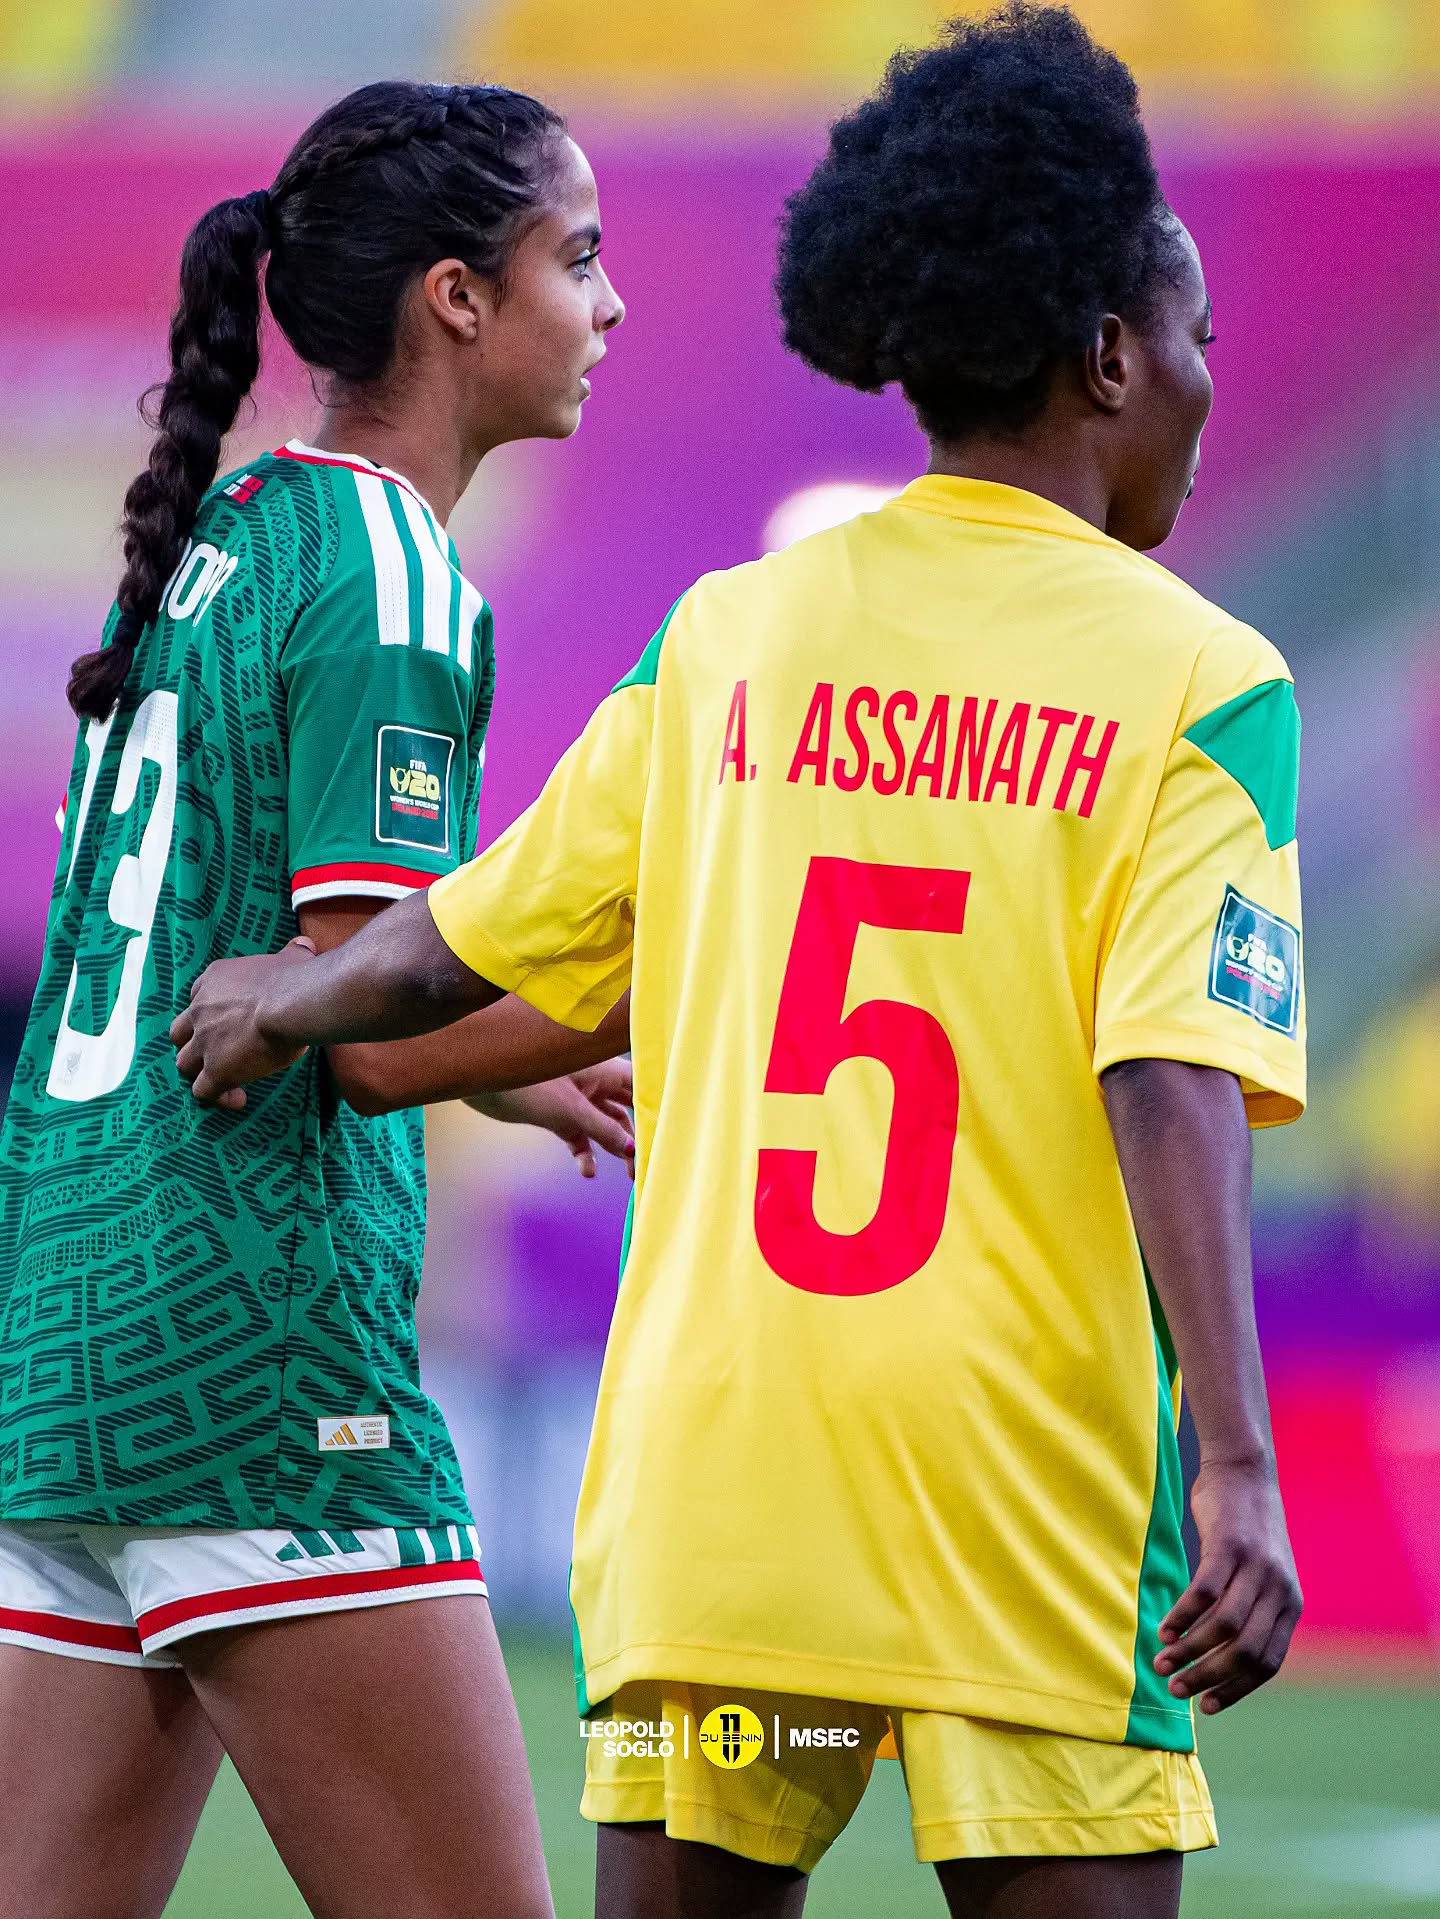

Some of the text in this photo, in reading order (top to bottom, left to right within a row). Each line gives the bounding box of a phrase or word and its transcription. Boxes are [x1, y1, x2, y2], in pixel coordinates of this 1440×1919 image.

[409, 759, 427, 771] FIFA
[719, 680, 1121, 819] A. ASSANATH
[753, 855, 972, 1297] 5
